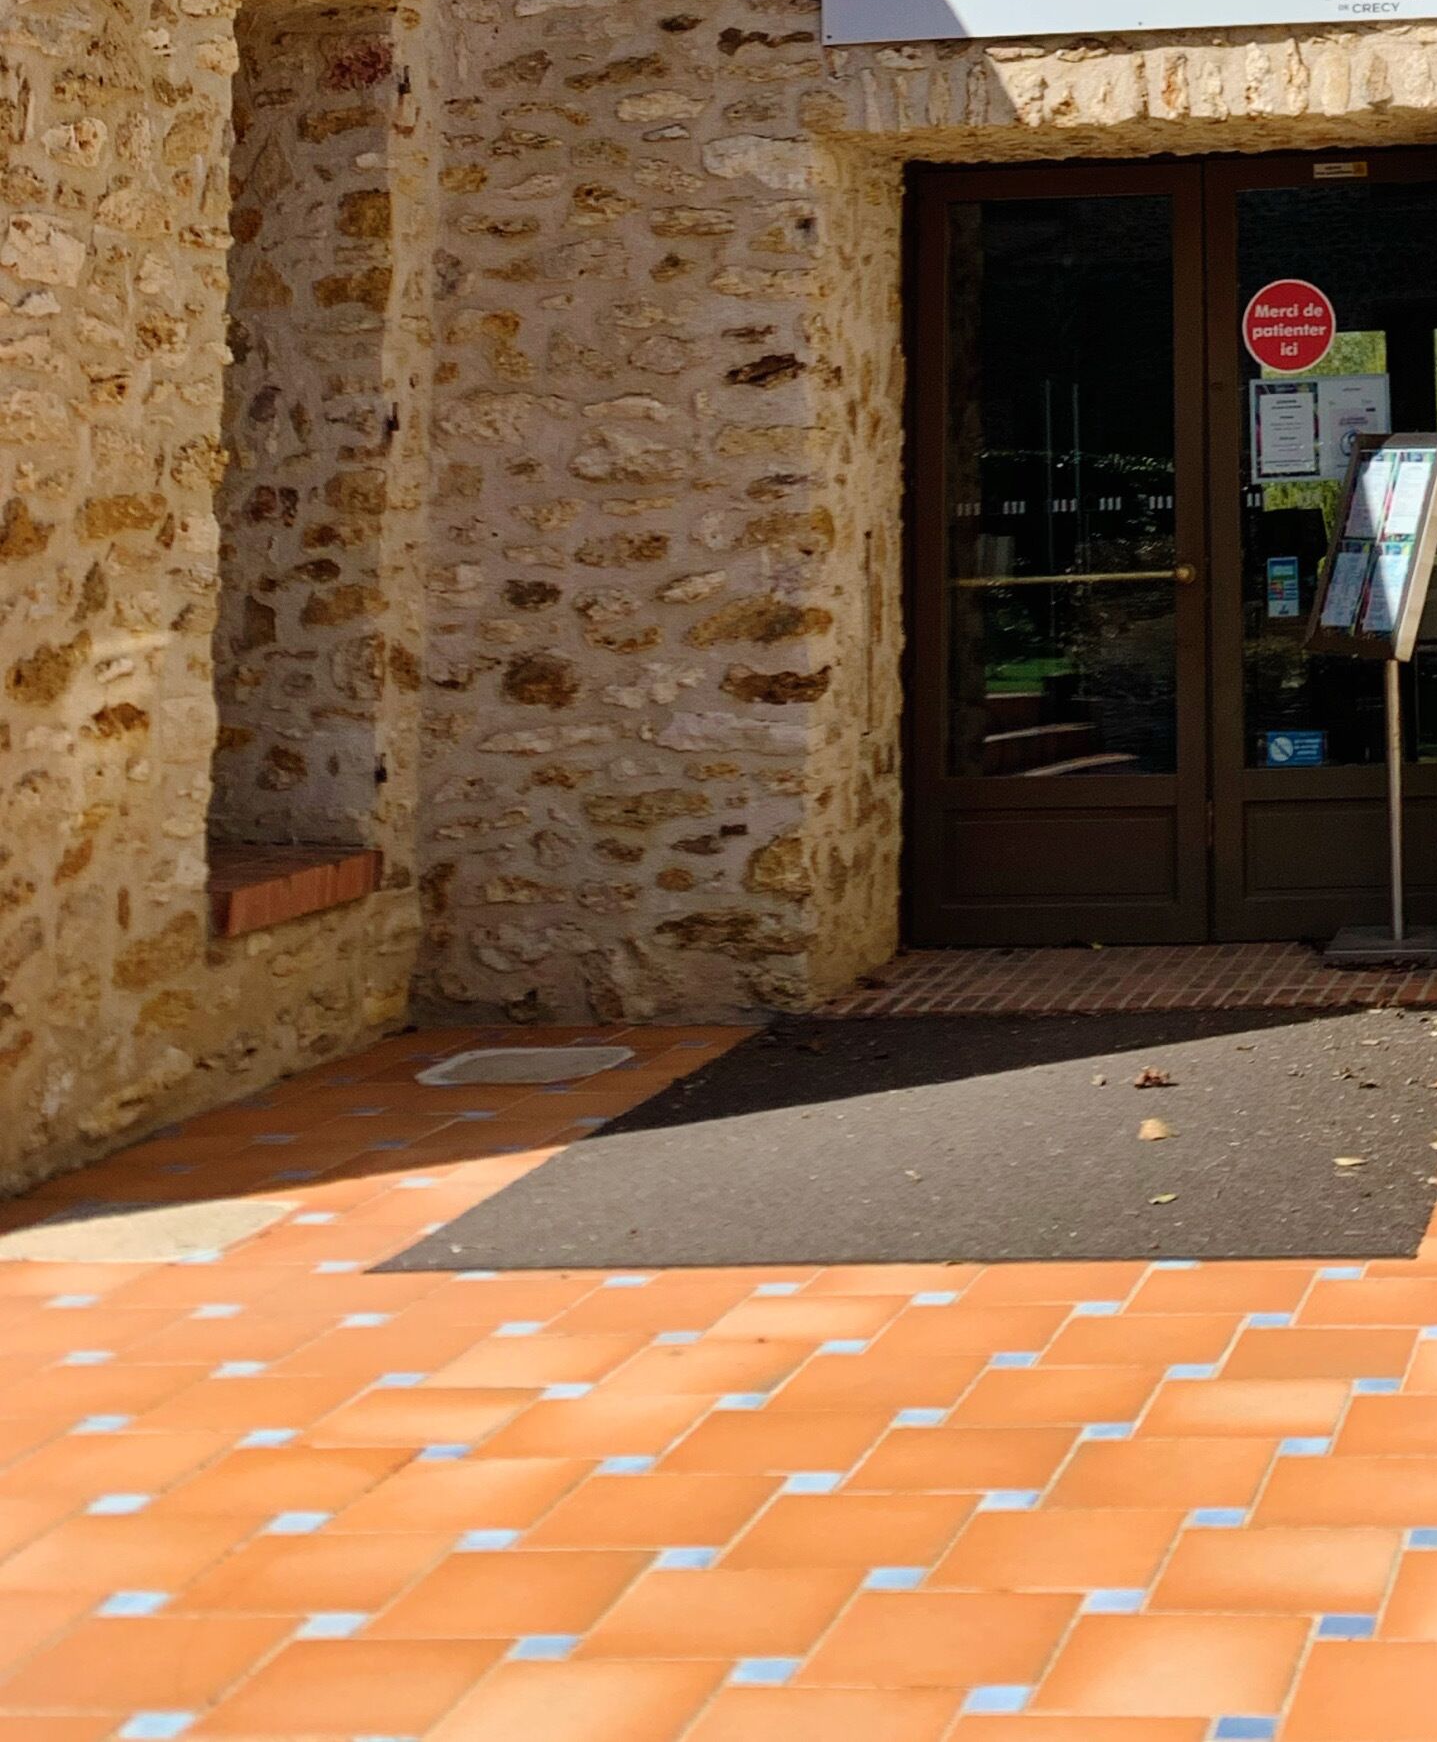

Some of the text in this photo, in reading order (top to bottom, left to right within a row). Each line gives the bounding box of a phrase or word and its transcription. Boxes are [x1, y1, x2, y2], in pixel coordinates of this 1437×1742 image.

[1352, 1, 1400, 14] CRECY
[1254, 302, 1324, 318] Merci de
[1252, 323, 1327, 341] patienter
[1280, 341, 1299, 357] ici
